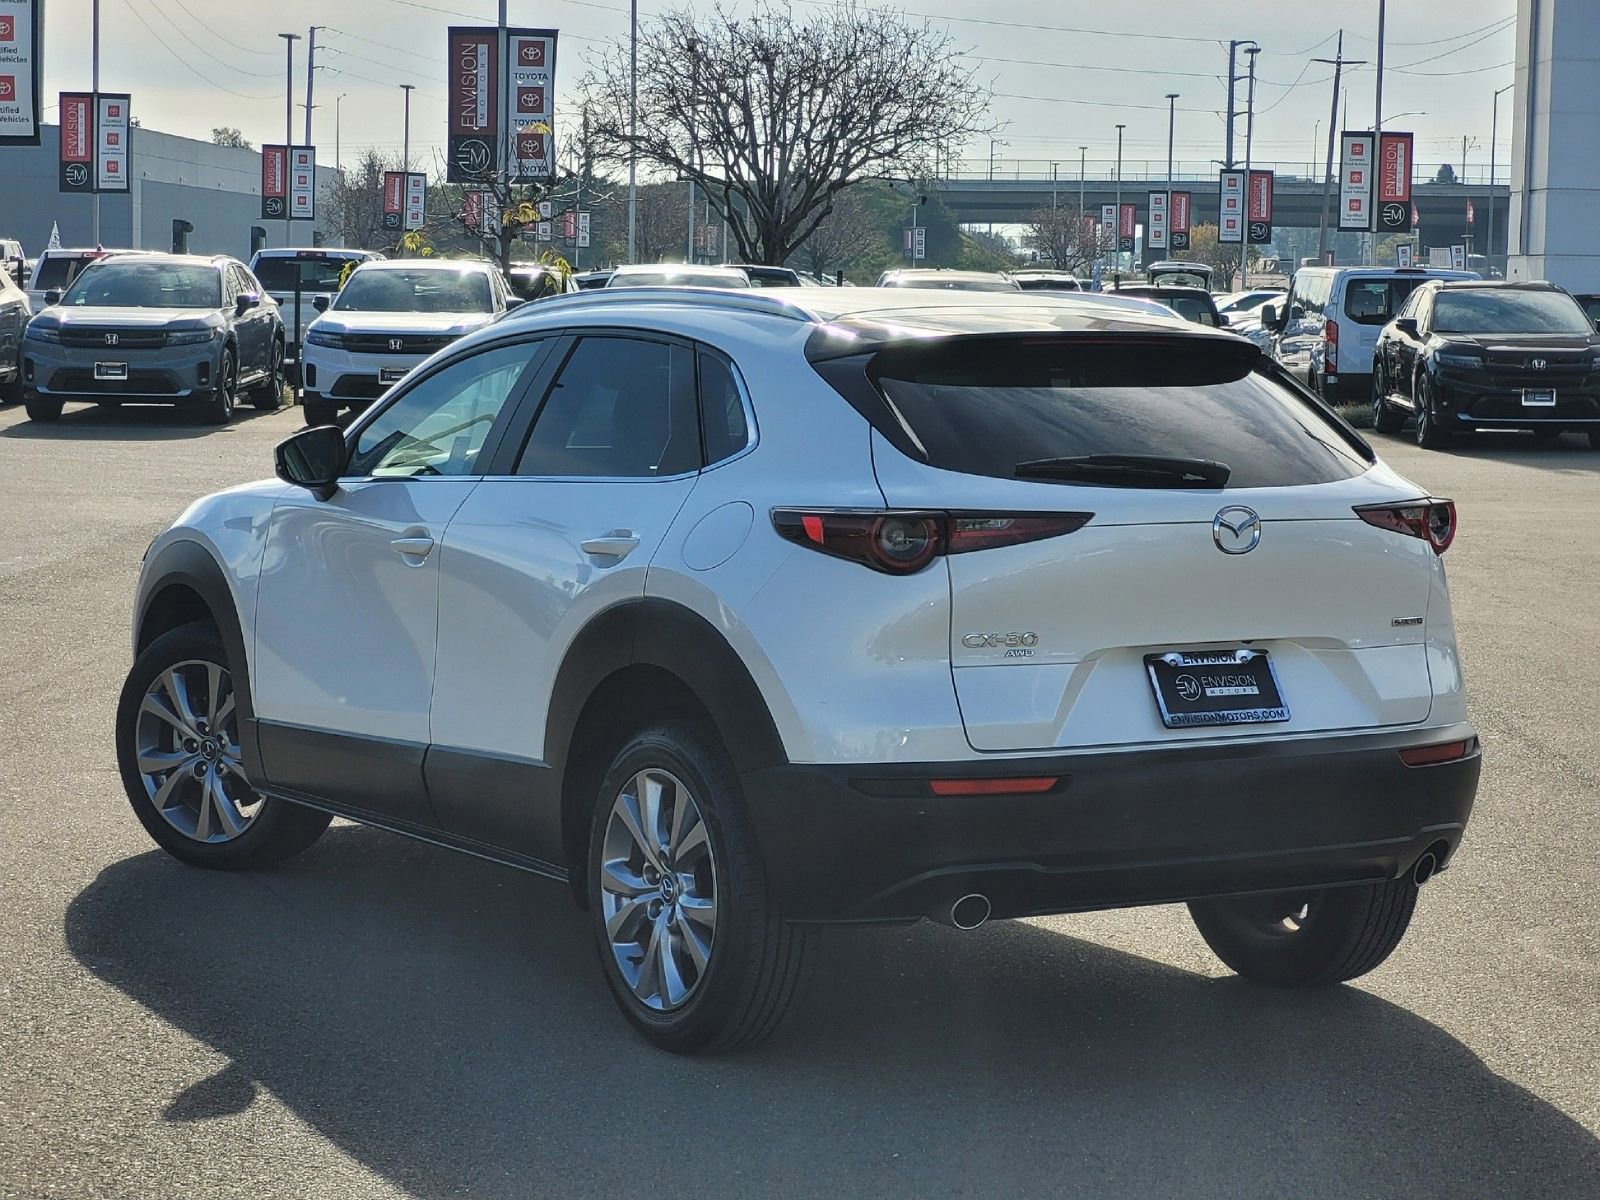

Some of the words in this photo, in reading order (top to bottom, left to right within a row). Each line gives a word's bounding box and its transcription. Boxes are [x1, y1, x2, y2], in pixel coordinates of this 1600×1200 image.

[513, 72, 549, 81] TOYOTA
[461, 43, 477, 127] ENVISION
[479, 51, 487, 120] MOTORS
[67, 102, 78, 157] ENVISION
[513, 118, 548, 127] TOYOTA
[267, 151, 276, 193] ENVISION
[513, 165, 548, 173] TOYOTA
[1385, 142, 1398, 197] ENVISION
[1253, 177, 1262, 218] ENVISION
[961, 631, 1039, 649] CX-30
[1003, 648, 1034, 658] AWD
[1182, 653, 1237, 665] ENVISION
[1201, 675, 1257, 688] ENVISION
[1170, 710, 1285, 725] ENVISIONMOTORS.COM
